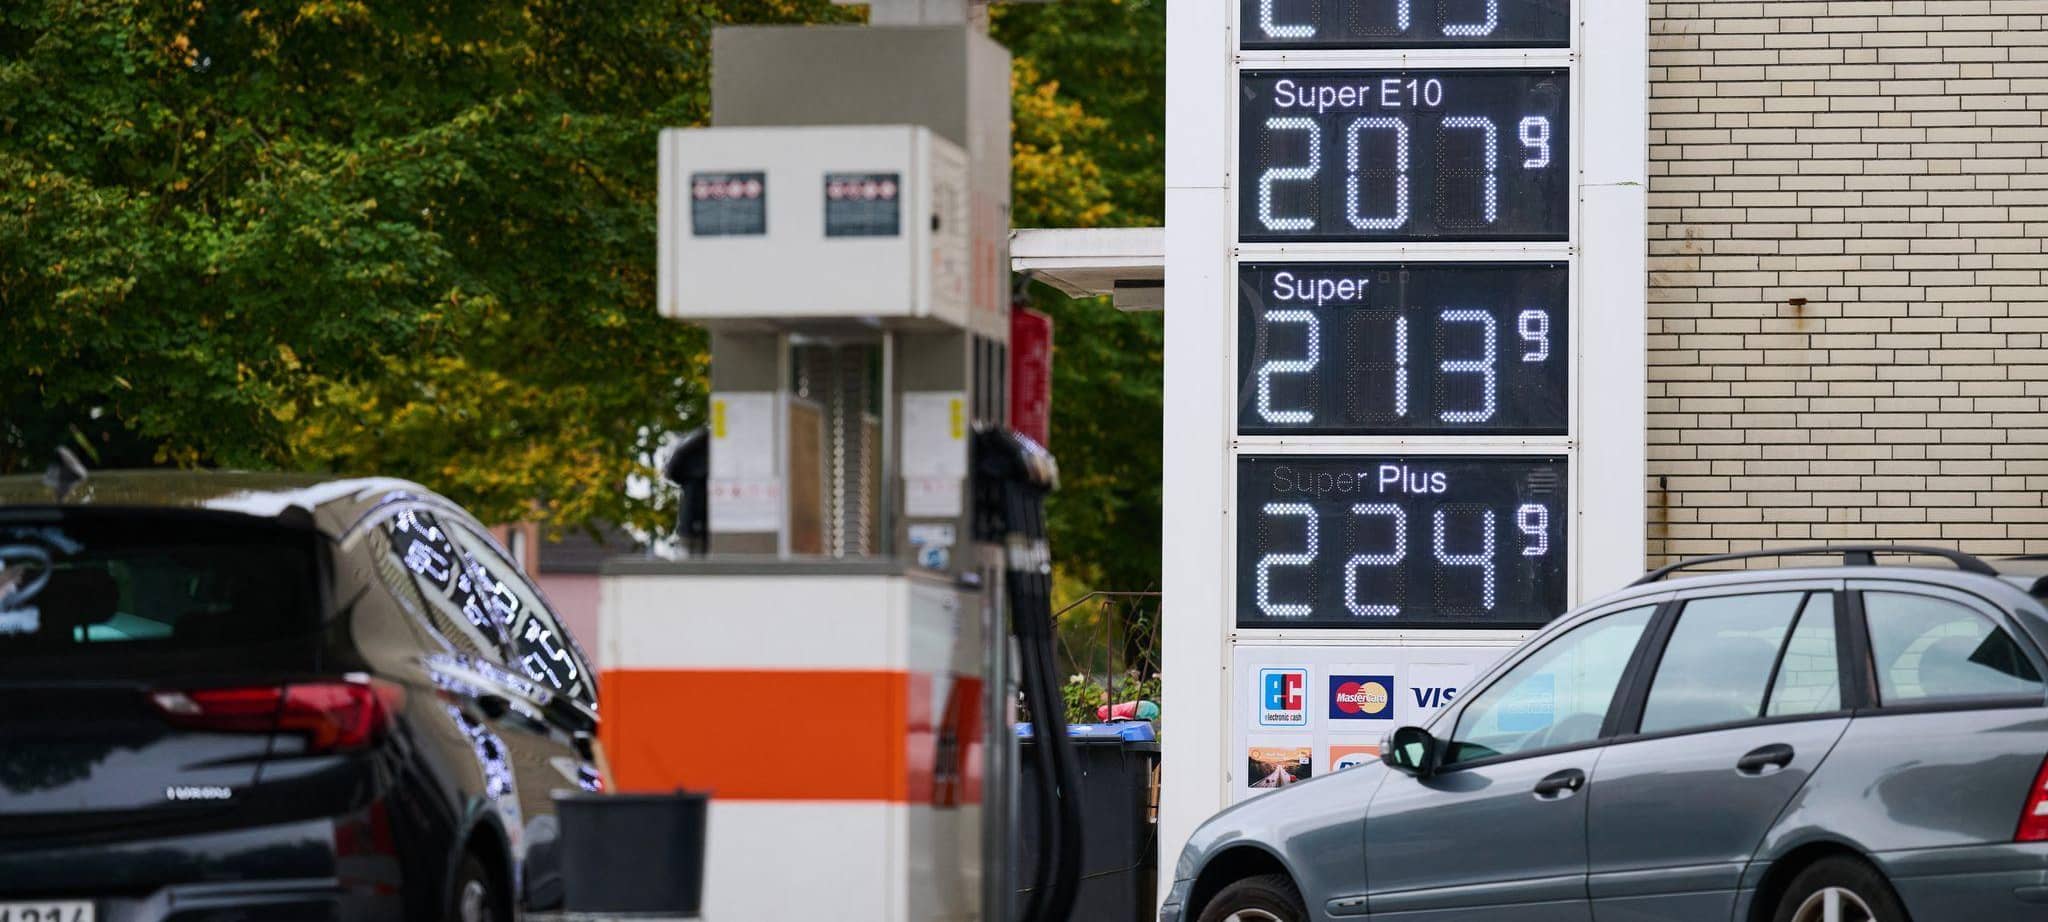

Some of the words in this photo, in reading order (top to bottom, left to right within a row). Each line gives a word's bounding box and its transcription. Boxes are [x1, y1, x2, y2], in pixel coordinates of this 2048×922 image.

[1273, 78, 1371, 114] Super
[1380, 77, 1443, 107] E10
[1272, 271, 1370, 307] Super
[1272, 465, 1370, 499] Super
[1378, 463, 1447, 494] Plus
[1410, 687, 1457, 708] VIS
[1264, 712, 1289, 721] electronic
[1290, 712, 1302, 721] cash
